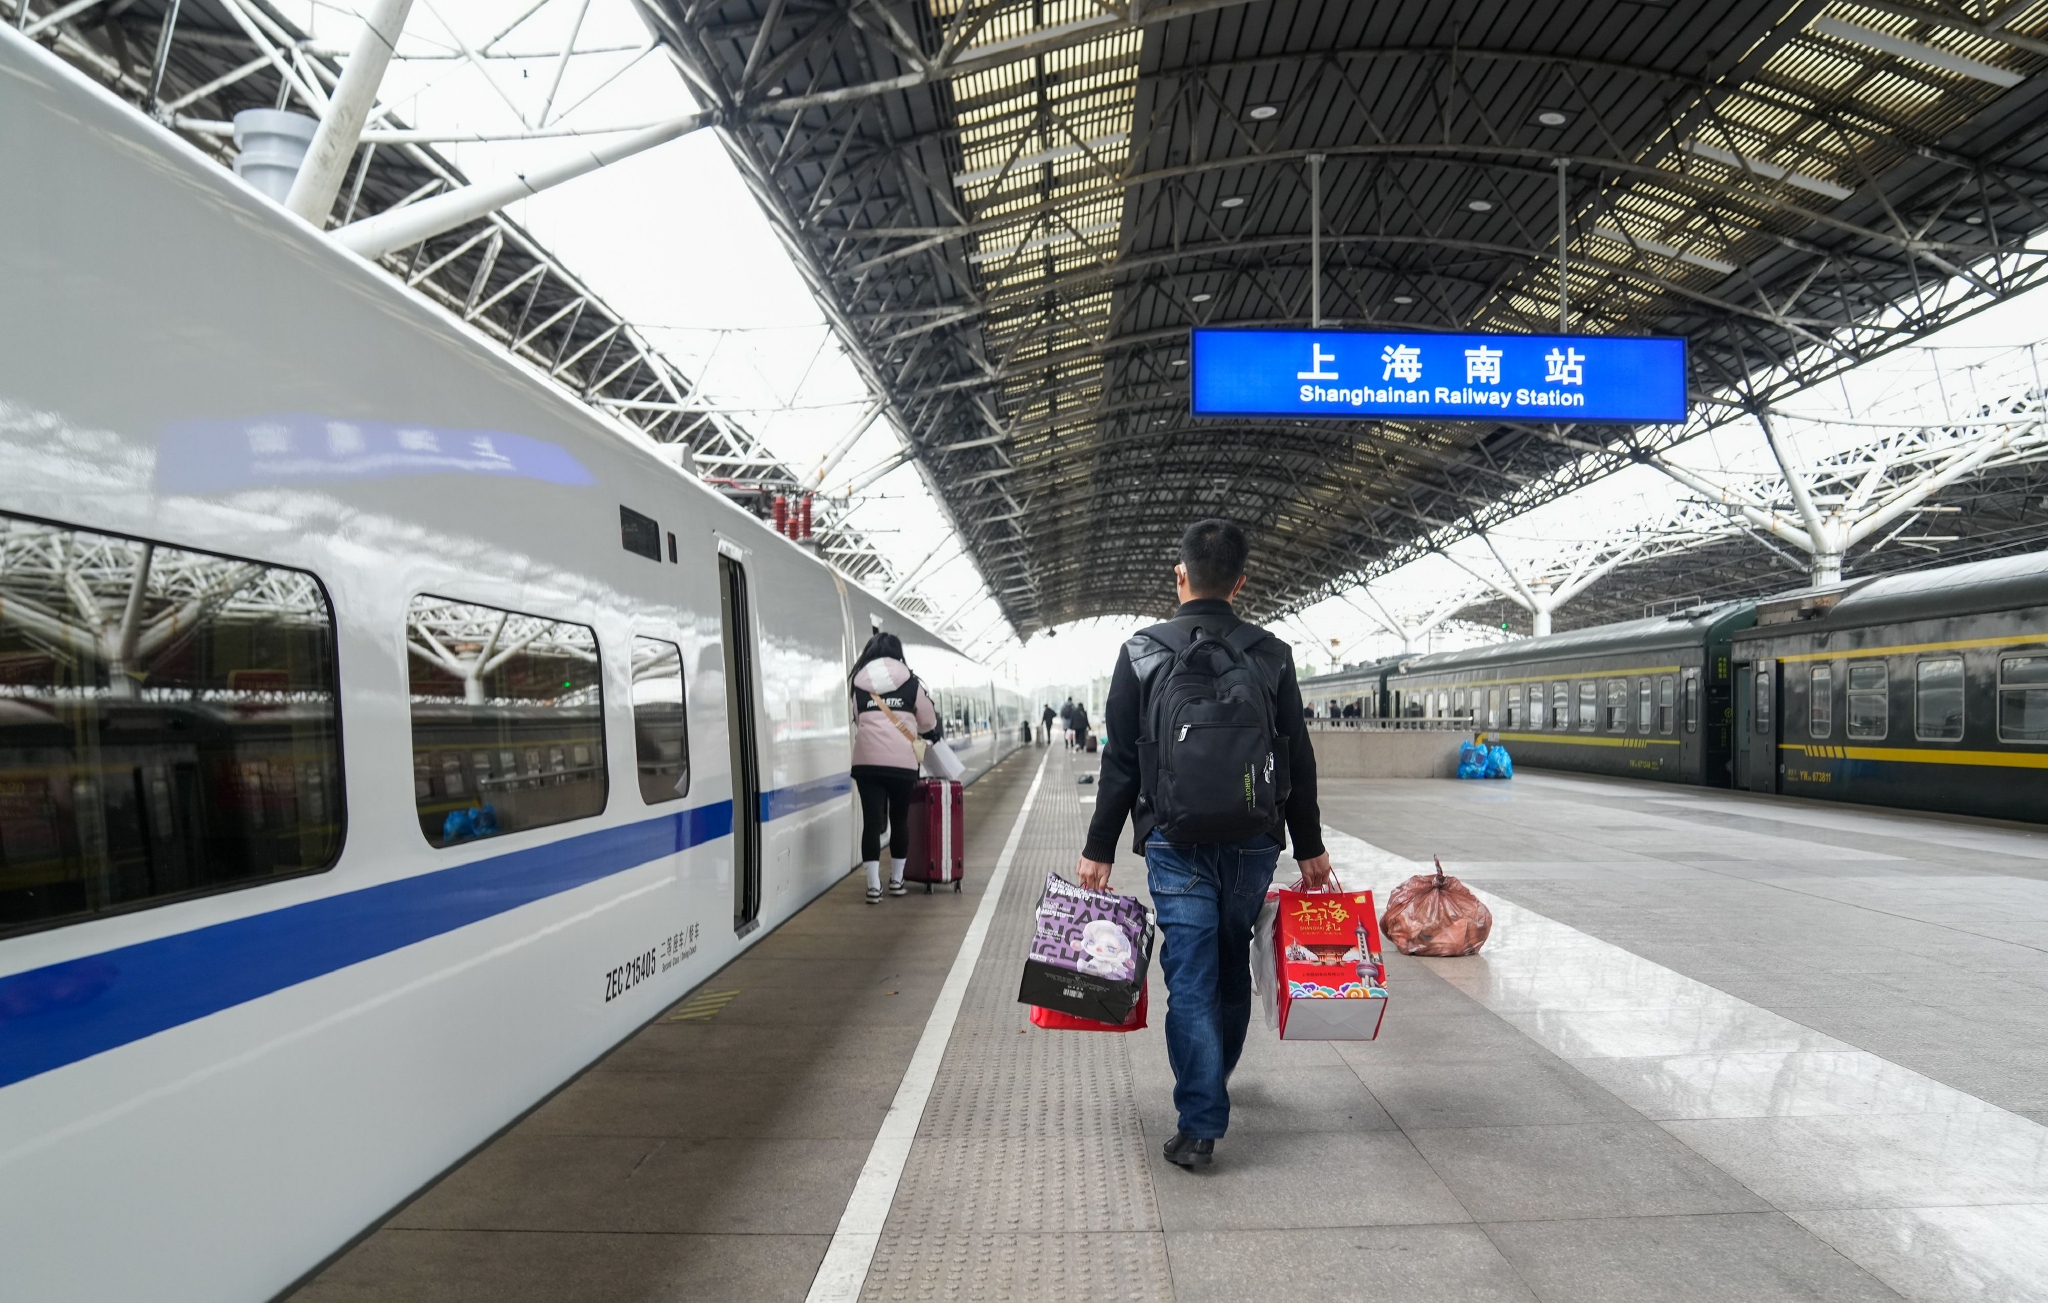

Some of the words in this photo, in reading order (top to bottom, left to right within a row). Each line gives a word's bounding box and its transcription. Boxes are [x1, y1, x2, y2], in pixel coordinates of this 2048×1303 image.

[1297, 343, 1586, 386] 上海南站
[1299, 384, 1430, 405] Shanghainan
[1435, 386, 1511, 409] Railway
[1516, 388, 1585, 407] Station
[1290, 900, 1350, 923] 上海
[605, 966, 624, 1003] ZEC
[625, 948, 656, 991] 215405
